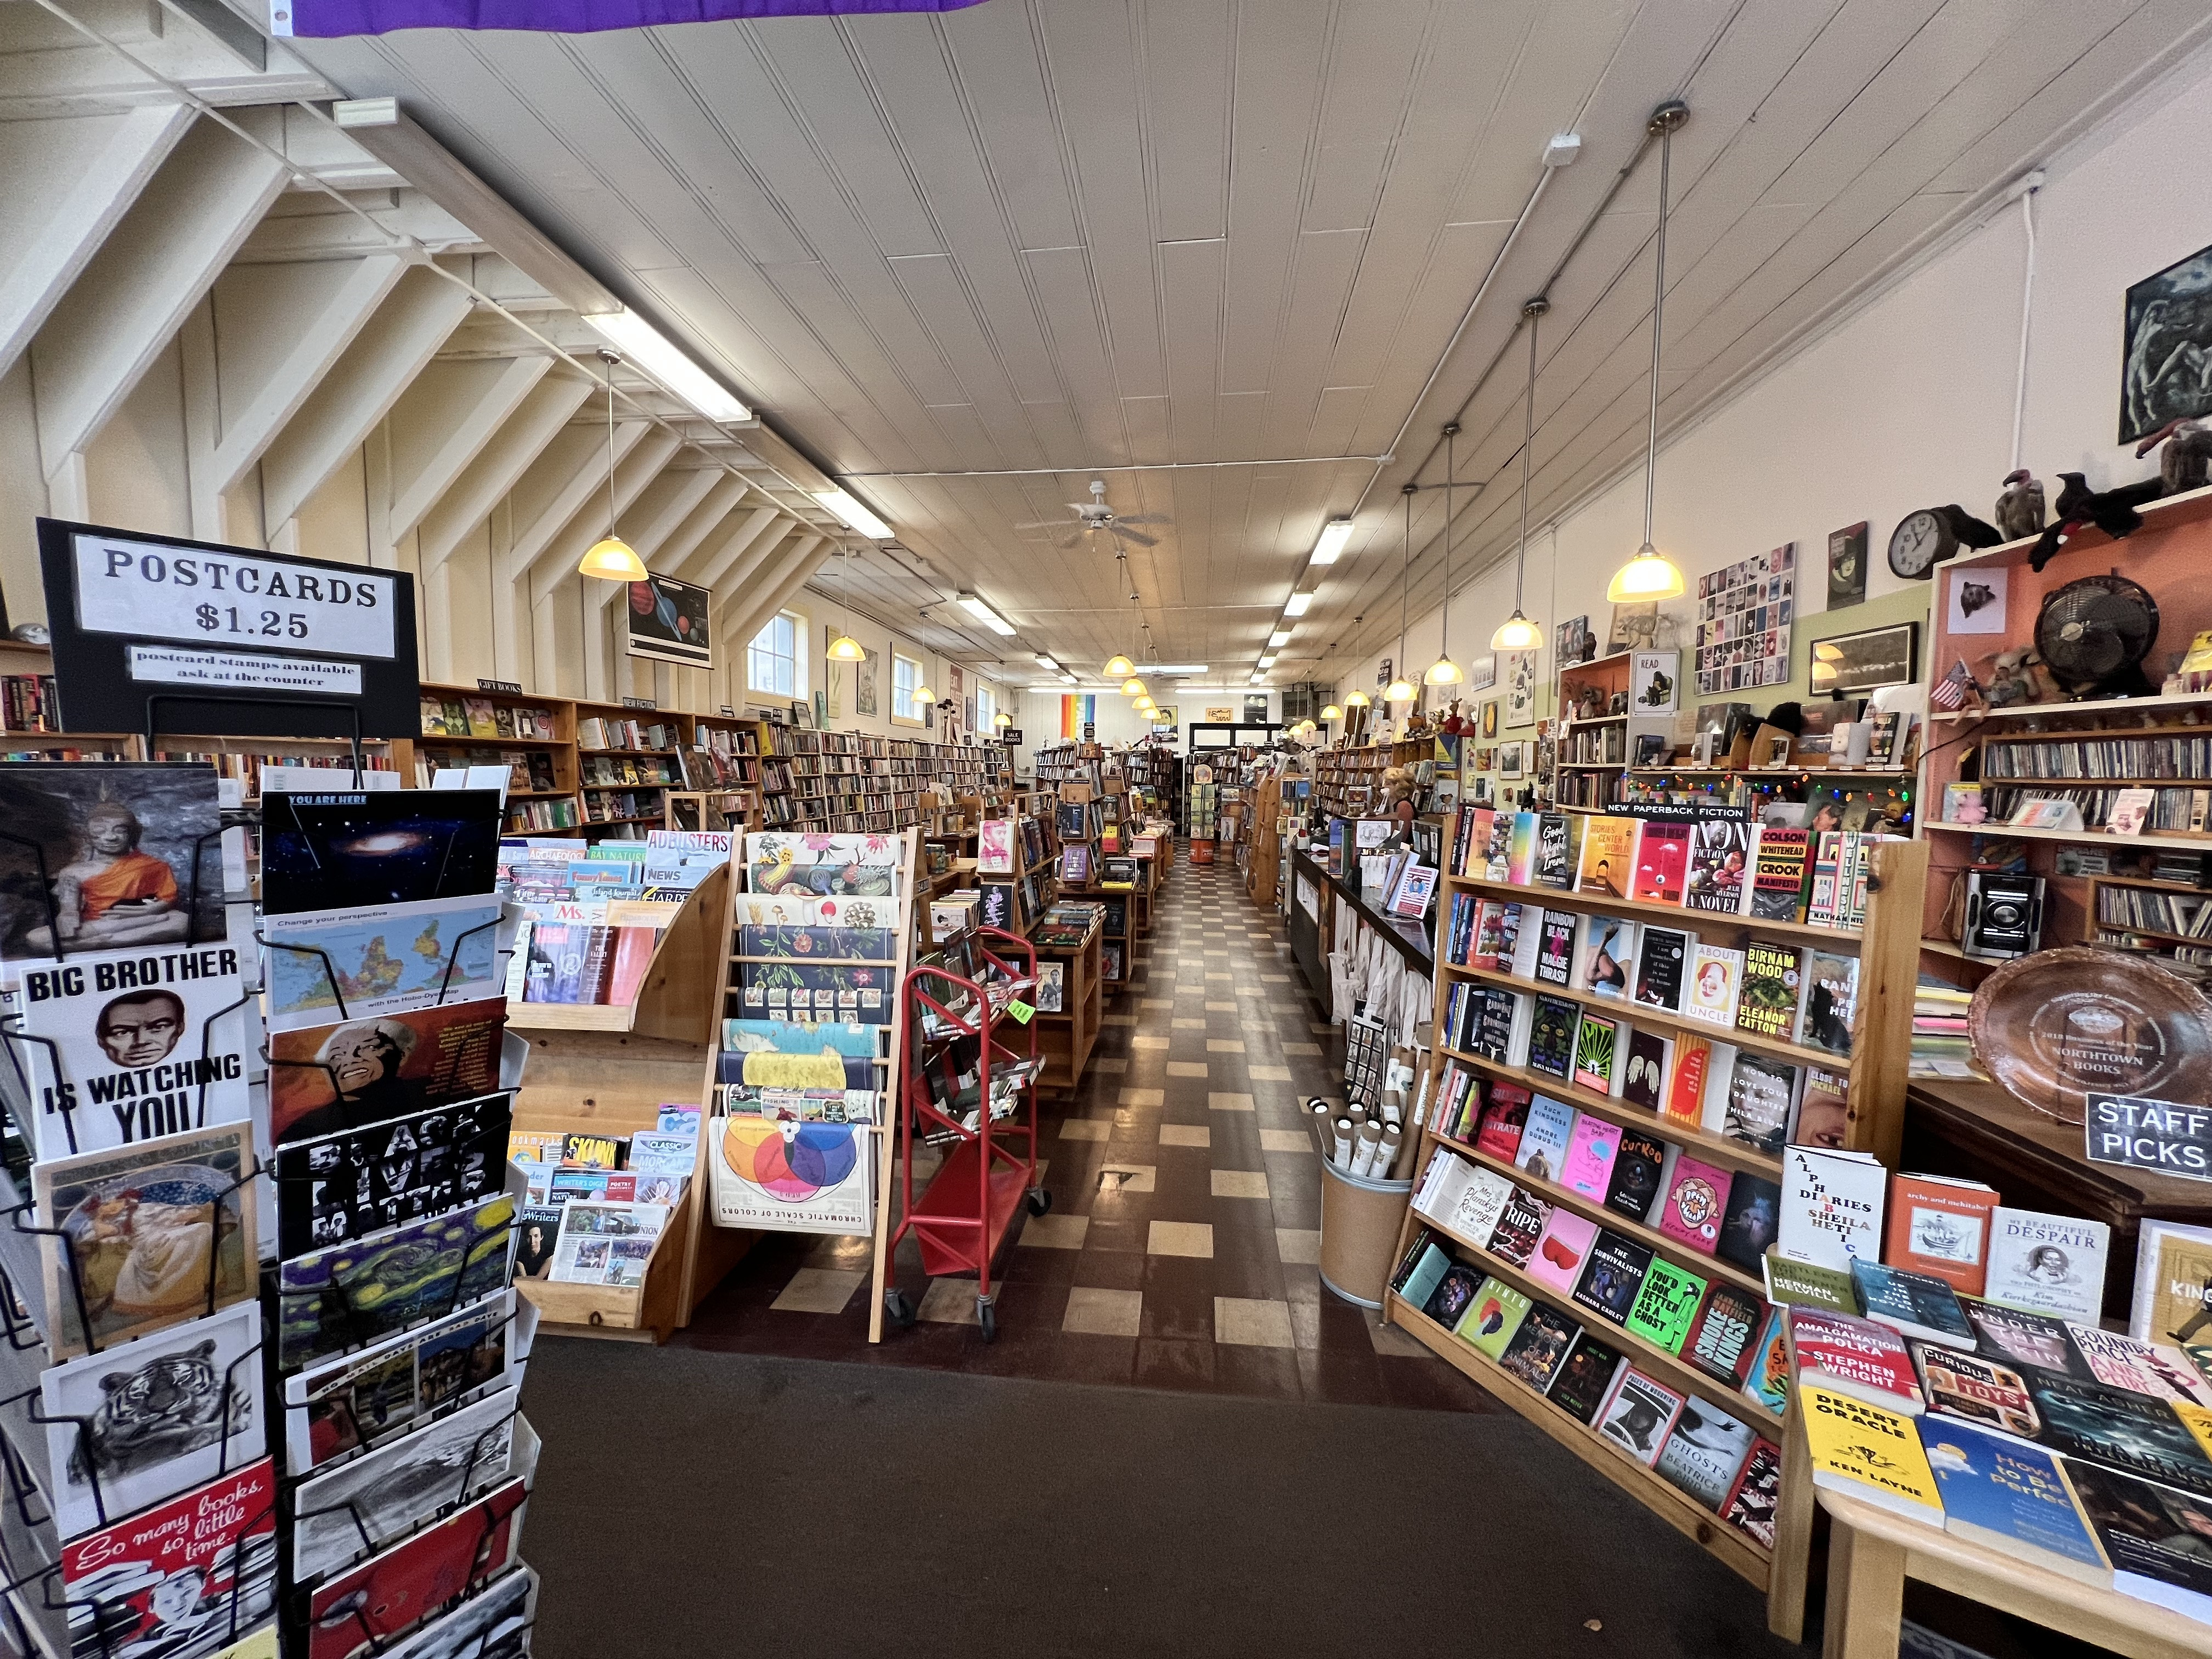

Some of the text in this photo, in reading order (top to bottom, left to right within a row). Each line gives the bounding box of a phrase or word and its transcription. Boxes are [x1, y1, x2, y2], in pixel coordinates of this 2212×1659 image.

[103, 549, 378, 608] POSTCARDS
[195, 603, 308, 639] $1.25
[137, 652, 355, 675] postcard stamps available
[1640, 658, 1659, 670] READ
[177, 669, 325, 686] ask at the counter
[480, 681, 521, 693] GIFT BOOKS
[624, 698, 656, 709] NEW FICTION
[288, 795, 366, 805] YOU ARE HERE
[1607, 804, 1743, 817] NEW PAPERBACK FICTION
[1543, 820, 1565, 839] Good
[1590, 824, 1615, 833] STORIES
[1598, 834, 1623, 844] CENTER
[1696, 820, 1750, 851] NON
[1762, 831, 1806, 843] COLSON
[648, 831, 729, 852] ADBUSTERS
[1541, 835, 1567, 855] Night
[1604, 844, 1629, 853] WORLD
[1760, 845, 1804, 856] WHITEHEAD
[529, 851, 585, 860] ARCHAEOLOGY
[590, 851, 606, 860] BAY
[1693, 848, 1728, 860] FICTION
[648, 868, 681, 881] NEWS
[1760, 863, 1800, 877] CROOK
[614, 887, 641, 897] Journal
[1756, 877, 1799, 889] MANIFESTO
[277, 918, 314, 928] Change
[316, 916, 337, 926] your
[555, 905, 585, 920] Ms.
[1544, 910, 1576, 928] RAINBOW
[1547, 925, 1570, 941] BLACK
[1541, 952, 1568, 970] MAGGIE
[1698, 946, 1736, 961] ABOUT
[1747, 948, 1795, 969] BIRNAM
[26, 949, 238, 1003] BIG BROTHER
[1538, 964, 1567, 983] THRASH
[1746, 961, 1783, 979] WOOD
[1689, 1005, 1729, 1023] UNCLE
[1739, 1004, 1786, 1026] ELEANOR
[1737, 1017, 1778, 1035] CATTON
[2052, 1046, 2143, 1066] NORTHTOWN
[1742, 1066, 1784, 1084] HOW TO
[1810, 1069, 1849, 1088] CLOSE TO
[2073, 1061, 2121, 1075] BOOKS
[43, 1053, 242, 1115] IS WATCHING
[1733, 1077, 1789, 1098] LOVE YOUR
[1809, 1078, 1841, 1096] MICHAEL
[1543, 1105, 1561, 1116] SUCH
[1733, 1090, 1785, 1113] DAUGHTER
[1534, 1110, 1567, 1126] KINDNESS
[1730, 1106, 1784, 1130] HILA BLUM
[2098, 1101, 2209, 1136] STAFF
[650, 1141, 682, 1150] CLASSIC
[1529, 1131, 1551, 1146] DUBUS
[569, 1136, 617, 1166] SKUNK
[2102, 1132, 2207, 1169] PICKS
[1465, 1187, 1499, 1212] Plansky's
[1479, 1186, 1492, 1198] Mrs
[1799, 1189, 1872, 1213] DIARIES
[1907, 1192, 1988, 1211] archy and mehitabel
[721, 1207, 757, 1216] COLORS
[775, 1211, 803, 1219] SCALE
[808, 1212, 861, 1222] CHROMATIC
[1458, 1198, 1494, 1226] Revenge
[1505, 1206, 1541, 1235] RIPE
[1808, 1209, 1871, 1231] SHEILA
[1812, 1218, 1852, 1235] HETI
[2007, 1224, 2096, 1249] DESPAIR
[1593, 1248, 1643, 1278] SURVIVALISTS
[1613, 1247, 1629, 1260] THE
[1646, 1278, 1672, 1298] LOOK
[1651, 1268, 1679, 1289] YOU'D
[1774, 1277, 1832, 1296] HERMAN
[1487, 1280, 1527, 1309] KINTU
[1641, 1288, 1679, 1313] BETTER
[1774, 1283, 1841, 1304] MELVILLE
[1575, 1291, 1624, 1322] KASHANA CAULEY
[1637, 1299, 1660, 1317] AS A
[1541, 1312, 1561, 1330] THE
[1634, 1309, 1667, 1332] GHOST
[1833, 1321, 1855, 1332] THE
[1970, 1311, 2060, 1340] UNDER
[1523, 1322, 1564, 1351] MEMORY
[1695, 1307, 1728, 1359] SMOKE
[1795, 1321, 1901, 1353] AMALGAMATION
[1998, 1326, 2052, 1350] THE
[2070, 1327, 2155, 1357] COUNTRY
[322, 1383, 338, 1393] NO
[346, 1362, 377, 1379] MAIL
[384, 1344, 413, 1360] DAYS
[420, 1332, 441, 1344] ARE
[475, 1312, 497, 1323] DAYS
[1527, 1345, 1542, 1356] OF
[1713, 1317, 1750, 1371] KINGS
[1822, 1335, 1884, 1357] POLKA
[1997, 1341, 2062, 1365] SKIN
[2078, 1338, 2134, 1365] PLACE
[1506, 1351, 1547, 1383] ANIMALS
[1813, 1350, 1895, 1379] STEPHEN
[1924, 1348, 1994, 1385] CURIOUS
[1821, 1362, 1895, 1389] WRIGHT
[1963, 1384, 2021, 1406] TOYS
[2038, 1378, 2170, 1419] NEAL ASHER
[1816, 1393, 1899, 1427] DESERT
[1816, 1404, 1906, 1440] ORACLE
[1669, 1438, 1729, 1480] GHOSTS
[1995, 1452, 2051, 1480] How
[1666, 1453, 1721, 1492] BEATRICE
[1675, 1469, 1701, 1491] BIRD
[1830, 1460, 1922, 1498] KEN LAYNE
[1997, 1465, 2063, 1494] to Be
[161, 1507, 246, 1555] so little
[76, 1536, 126, 1571] So
[132, 1514, 190, 1546] many
